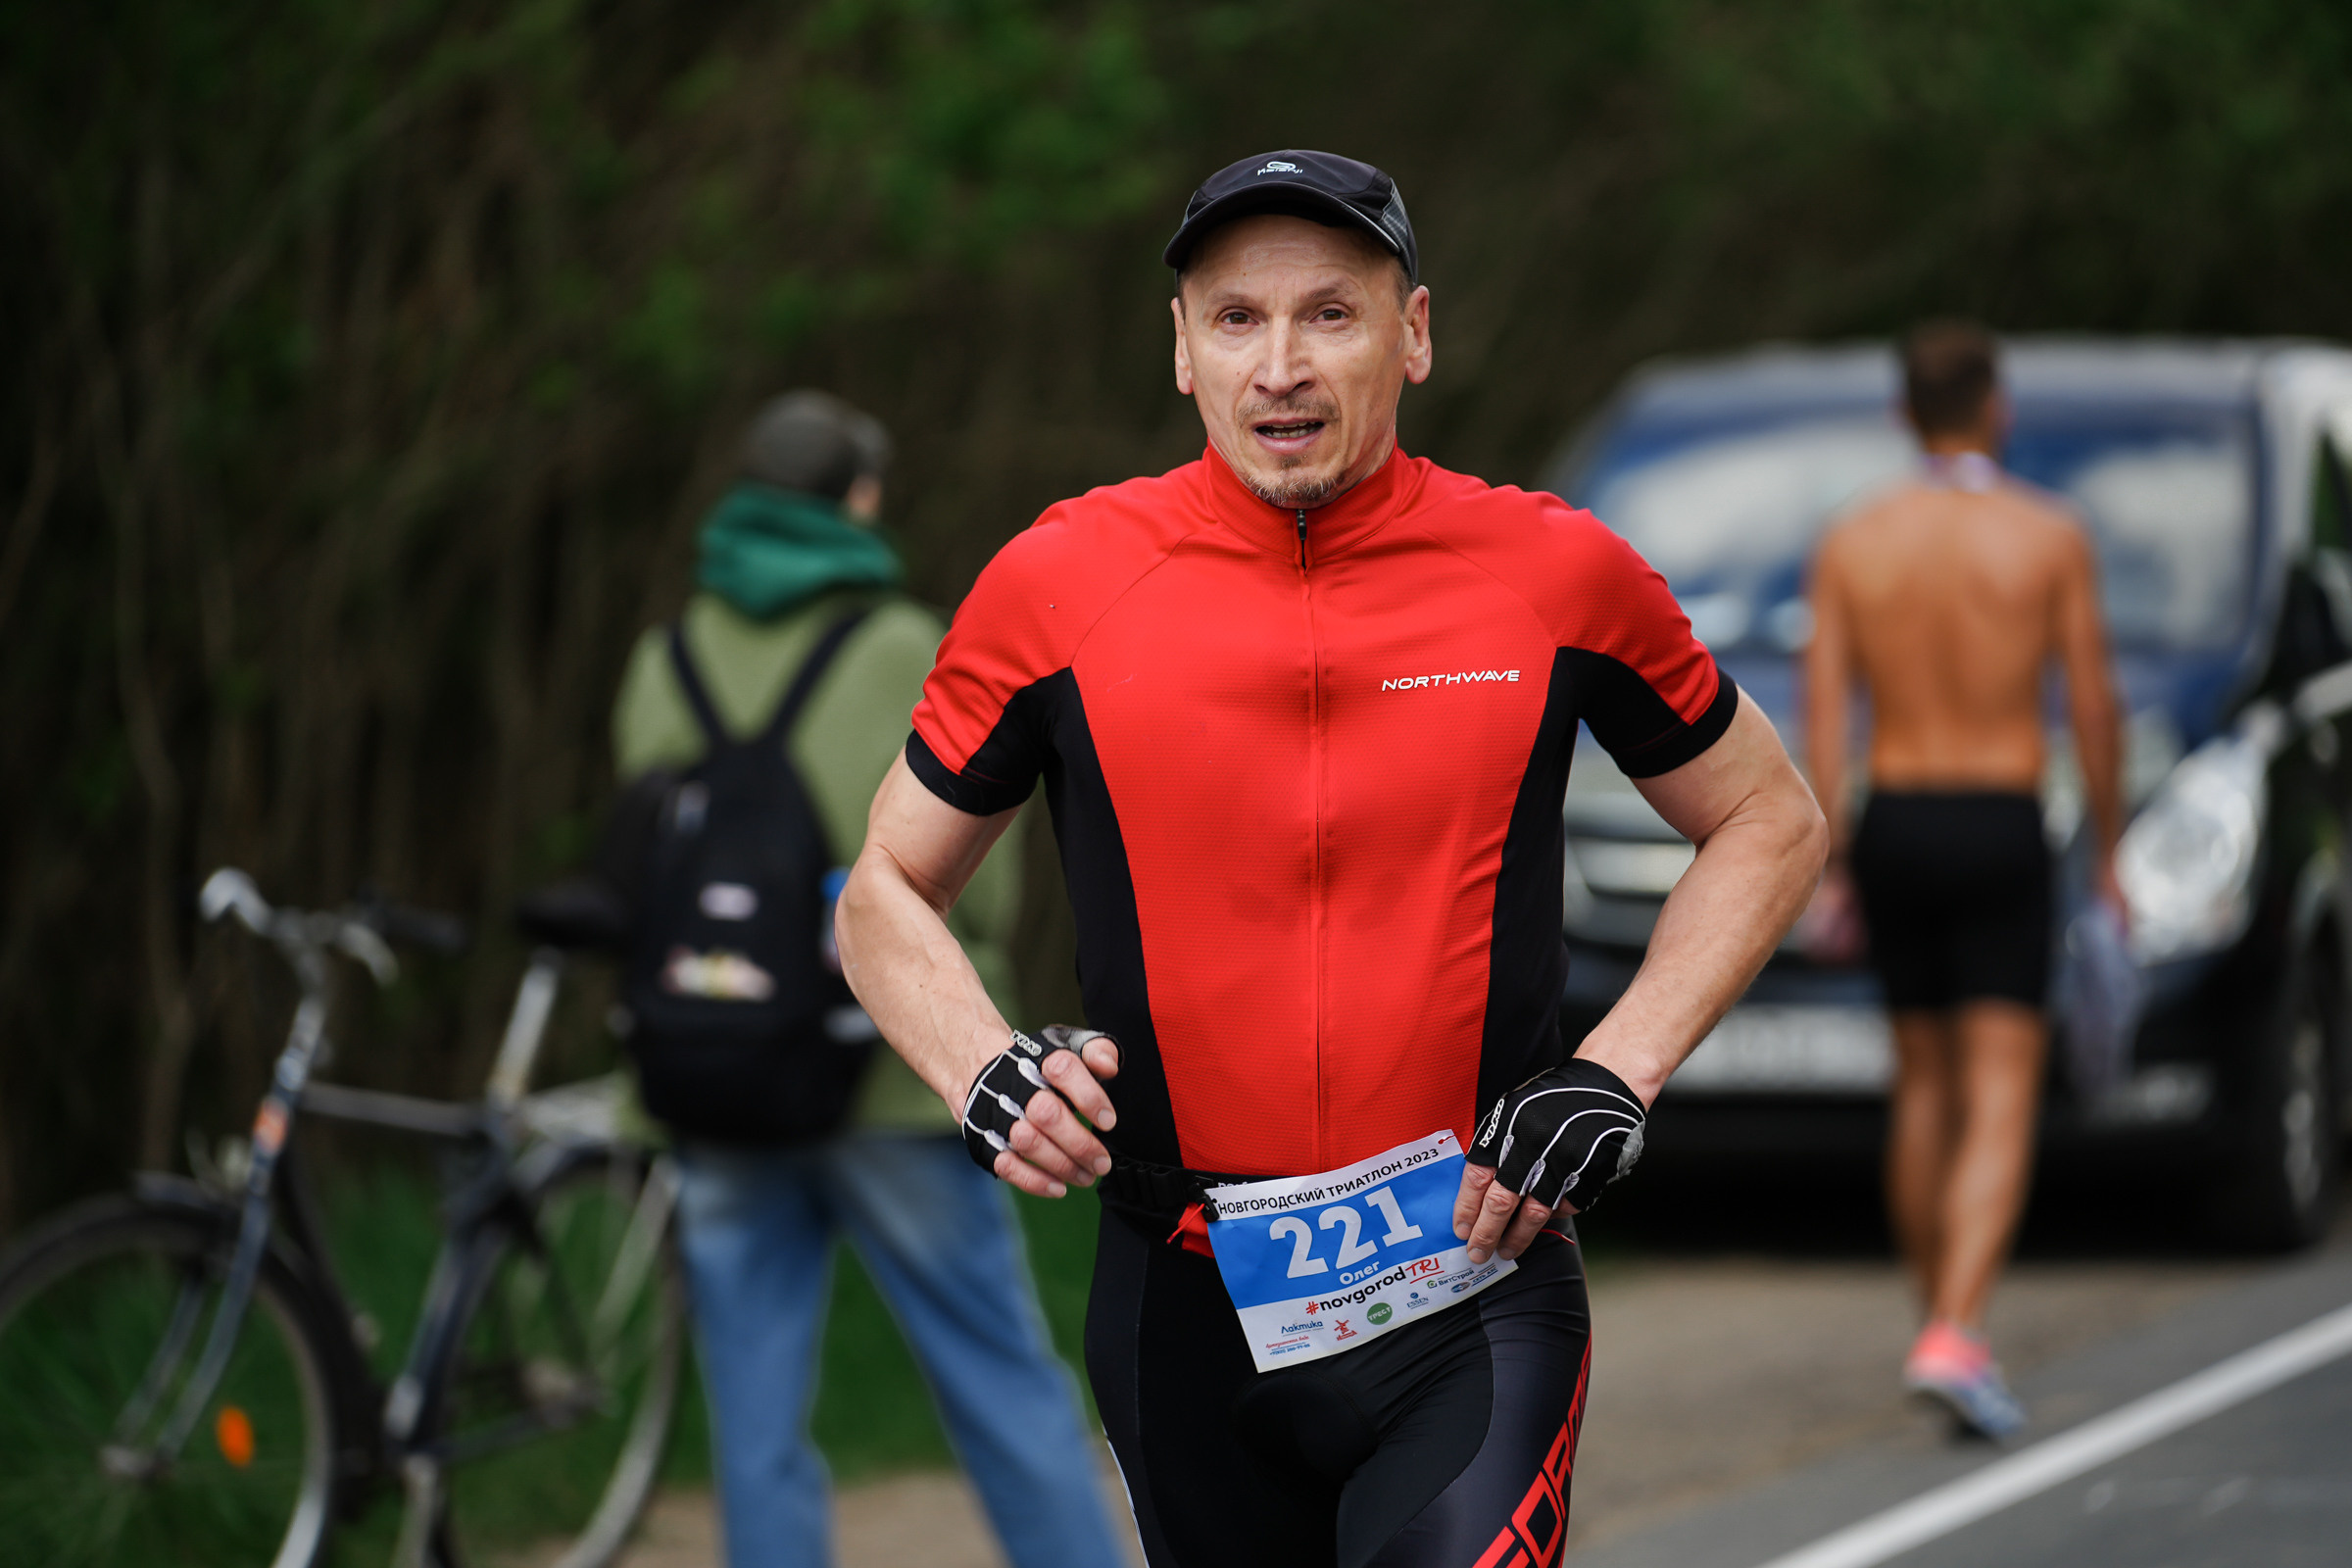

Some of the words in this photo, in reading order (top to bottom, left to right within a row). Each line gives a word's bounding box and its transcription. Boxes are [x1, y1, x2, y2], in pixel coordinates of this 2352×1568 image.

[1382, 669, 1520, 692] NORTHWAVE
[1217, 1187, 1326, 1215] НОВГОРОДСКИЙ
[1326, 1160, 1403, 1198] ТРИАТЛОН
[1403, 1148, 1440, 1168] 2023
[1269, 1186, 1423, 1279] 221
[1339, 1260, 1381, 1286] Олег
[1368, 1306, 1392, 1321] ТРЕСТ
[1406, 1297, 1429, 1308] ESSEN
[1281, 1320, 1324, 1334] Лактика
